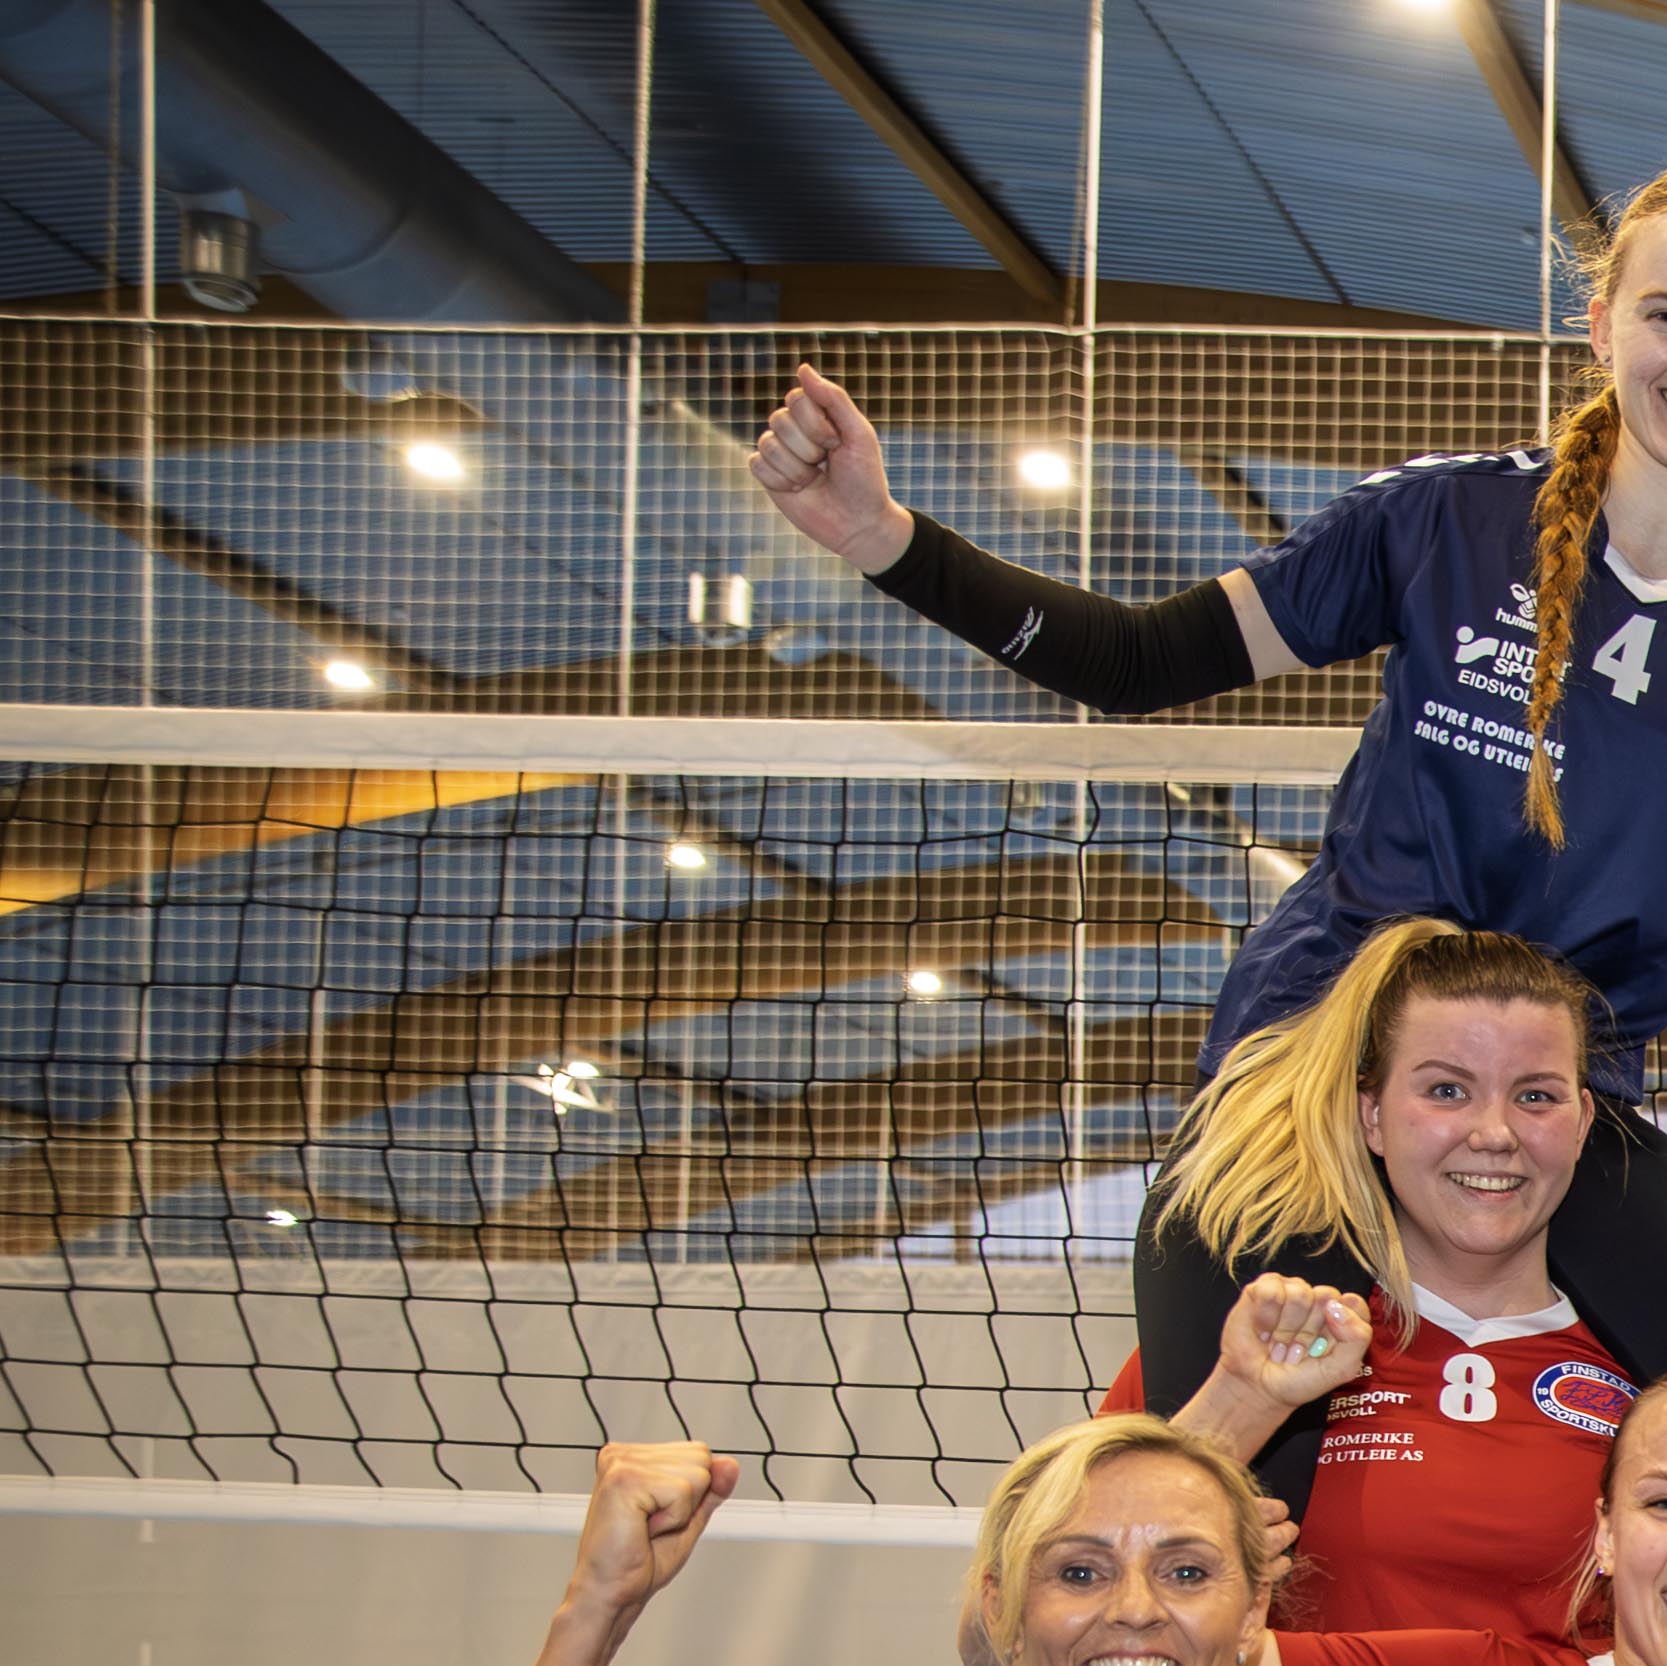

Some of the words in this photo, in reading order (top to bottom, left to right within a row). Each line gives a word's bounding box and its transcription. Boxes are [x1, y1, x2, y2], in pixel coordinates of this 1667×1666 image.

[1495, 607, 1538, 633] humm
[1592, 613, 1657, 706] 4
[1458, 669, 1533, 706] EIDSVOL
[1423, 700, 1470, 728] ØVRE
[1471, 716, 1566, 760] ROMERKE
[1414, 719, 1450, 745] SALG
[1453, 735, 1480, 755] OG
[1484, 743, 1532, 773] UTLEI
[1439, 1353, 1497, 1422] 8
[1561, 1365, 1631, 1391] FINSTAD
[1329, 1391, 1411, 1412] ERSPORT
[1537, 1387, 1549, 1396] 19
[1327, 1406, 1376, 1421] SVOLL
[1541, 1399, 1616, 1437] SPORTSKL
[1324, 1432, 1414, 1449] ROMERIKE
[1336, 1449, 1398, 1462] UTLEIE
[1400, 1449, 1424, 1462] AS
